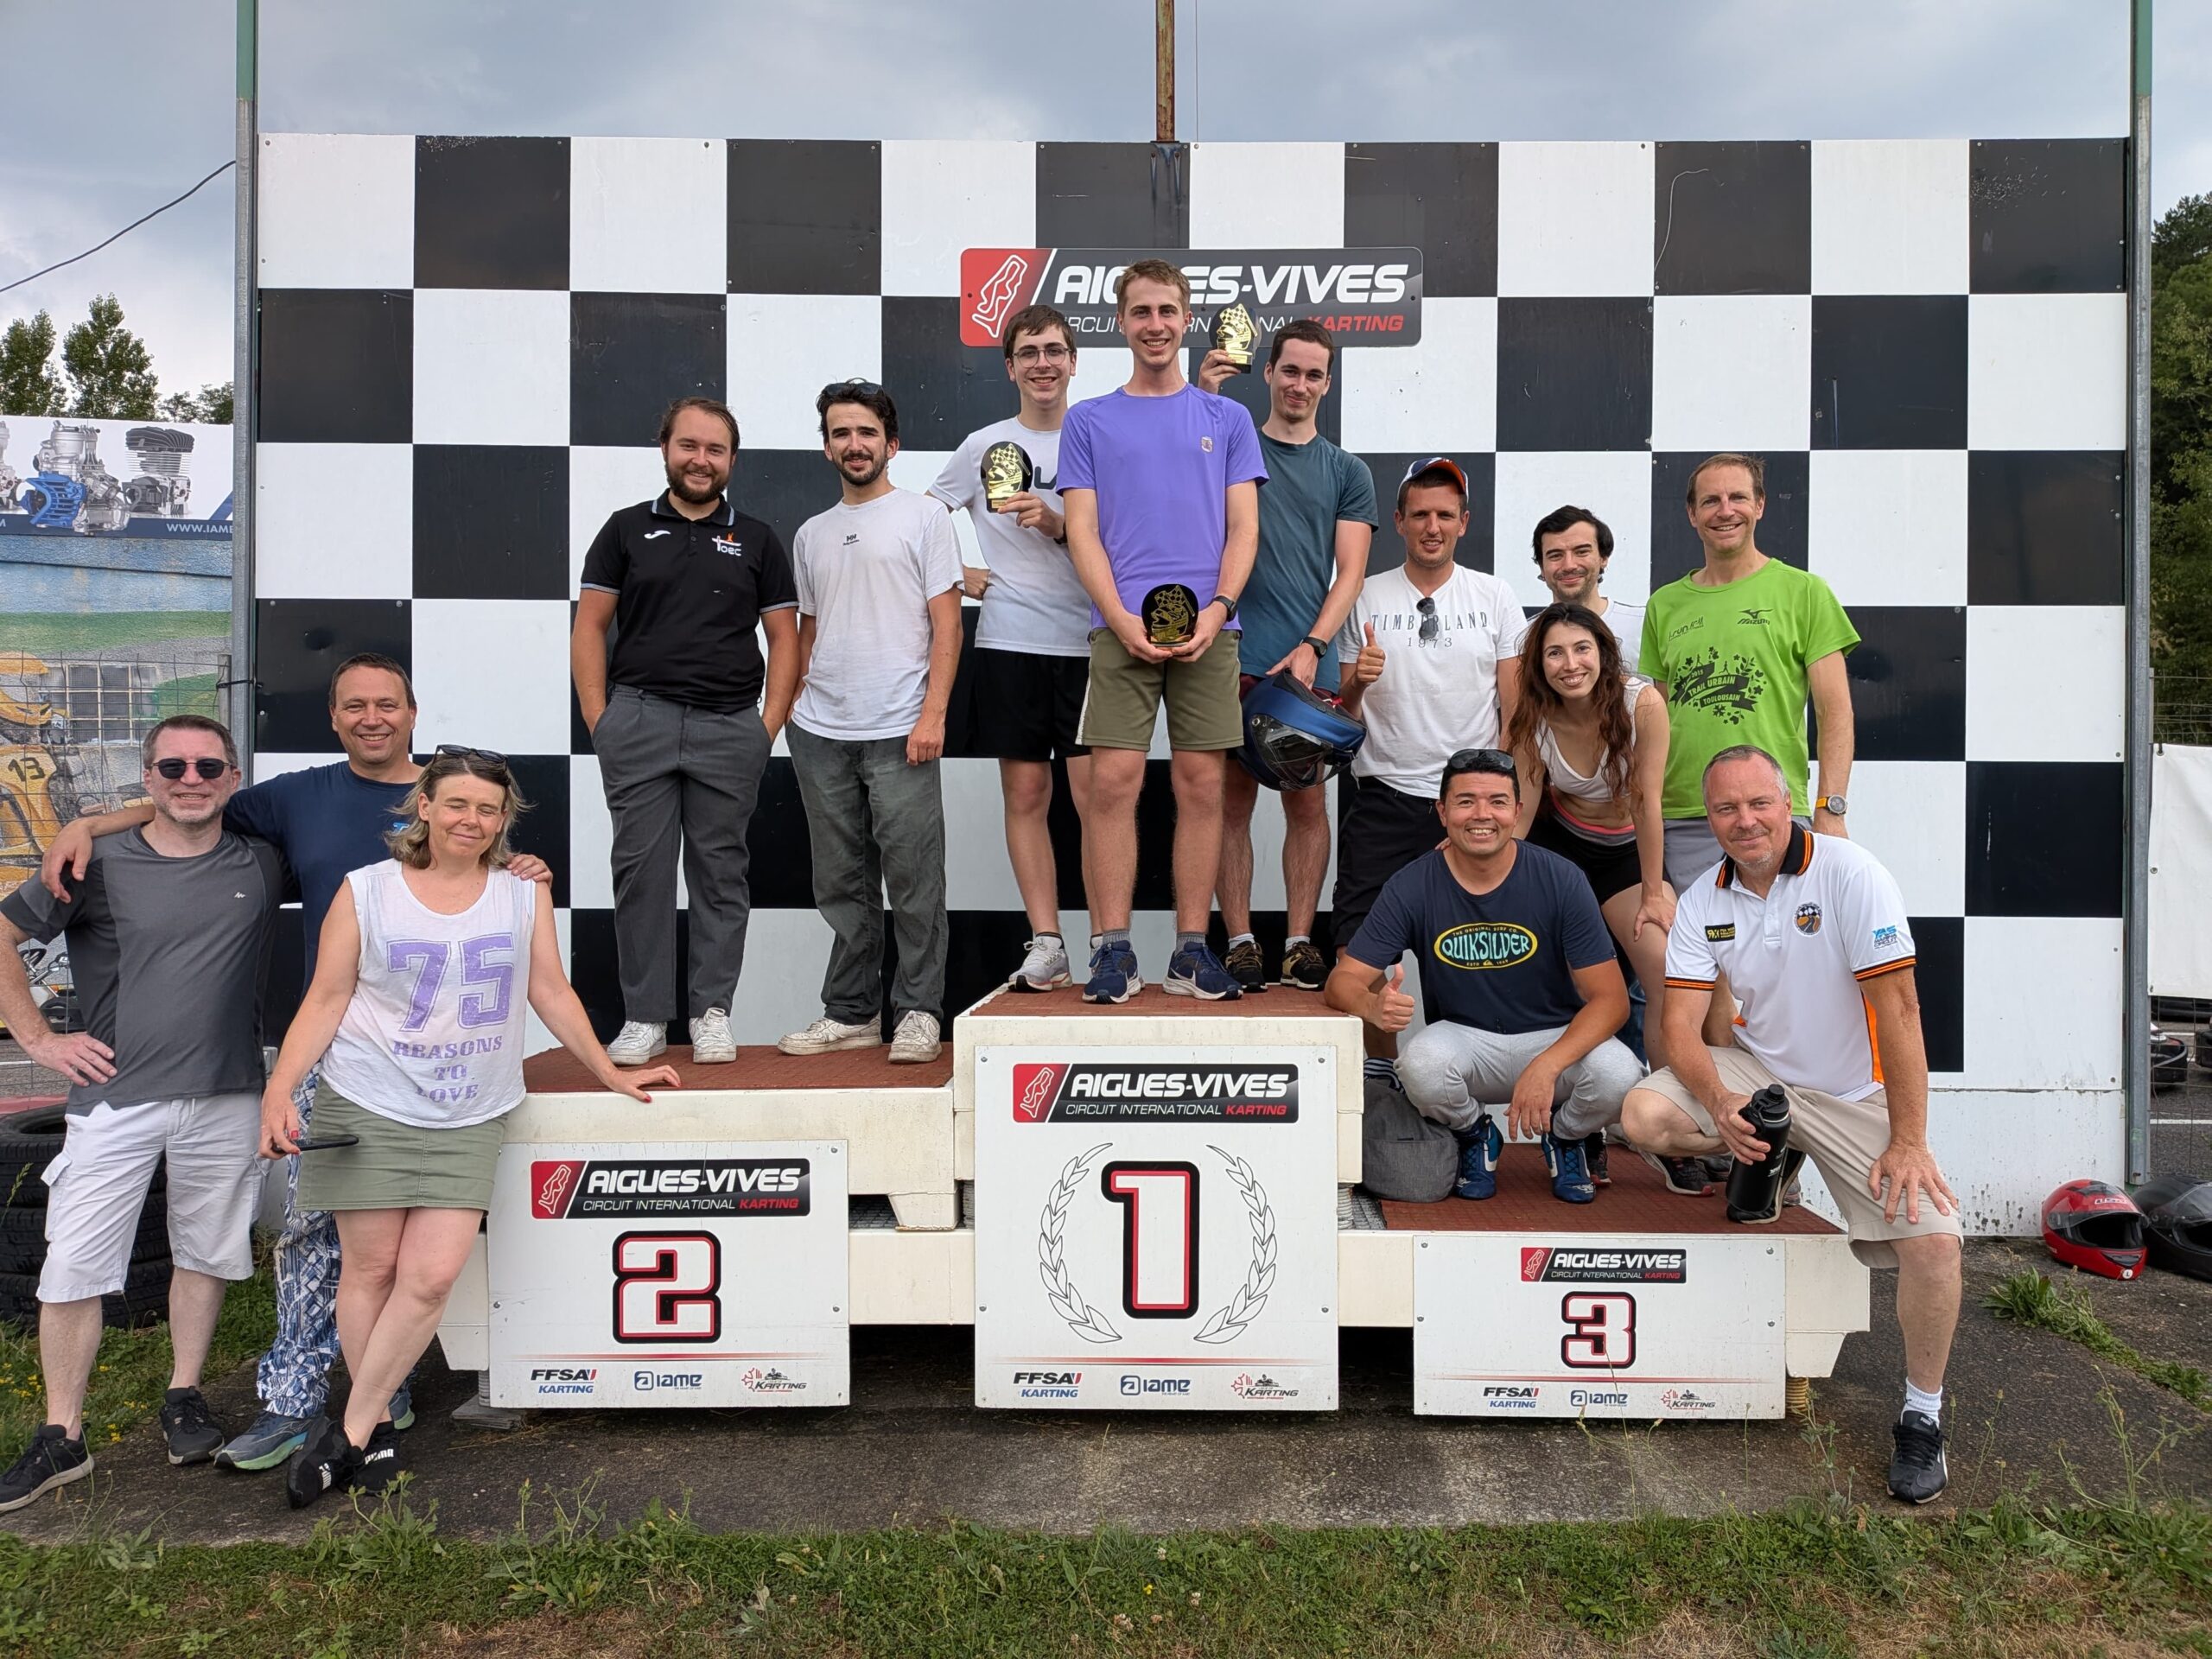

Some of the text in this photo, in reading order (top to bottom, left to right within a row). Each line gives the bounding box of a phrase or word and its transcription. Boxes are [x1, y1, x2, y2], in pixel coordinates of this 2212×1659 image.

[1306, 315, 1404, 332] ARTING
[1688, 682, 1707, 696] TRAIL
[1707, 676, 1736, 688] URBAIN
[1703, 693, 1741, 705] TOULOUSAIN
[8, 757, 45, 782] 13
[1441, 931, 1530, 960] QUIKSILVER
[386, 932, 514, 1033] 75
[392, 1036, 502, 1059] REASONS
[434, 1065, 467, 1081] TO
[415, 1084, 479, 1103] LOVE
[1070, 1073, 1289, 1098] AIGUES-VIVES
[1065, 1104, 1287, 1116] CIRCUIT INTERNATIONAL KARTING
[587, 1167, 801, 1194] AIGUES-VIVES
[582, 1198, 799, 1211] CIRCUIT INTERNATIONAL KARTING
[1101, 1161, 1200, 1319] 1
[1553, 1254, 1681, 1269] AIGUES-VIVES
[613, 1230, 721, 1344] 2
[1560, 1291, 1637, 1369] 3
[531, 1369, 591, 1381] FFSA
[1013, 1372, 1074, 1384] FFSA
[538, 1385, 594, 1394] KARTING
[1021, 1389, 1079, 1398] KARTING
[1245, 1388, 1300, 1396] KARTING
[1483, 1387, 1534, 1397] FFSA
